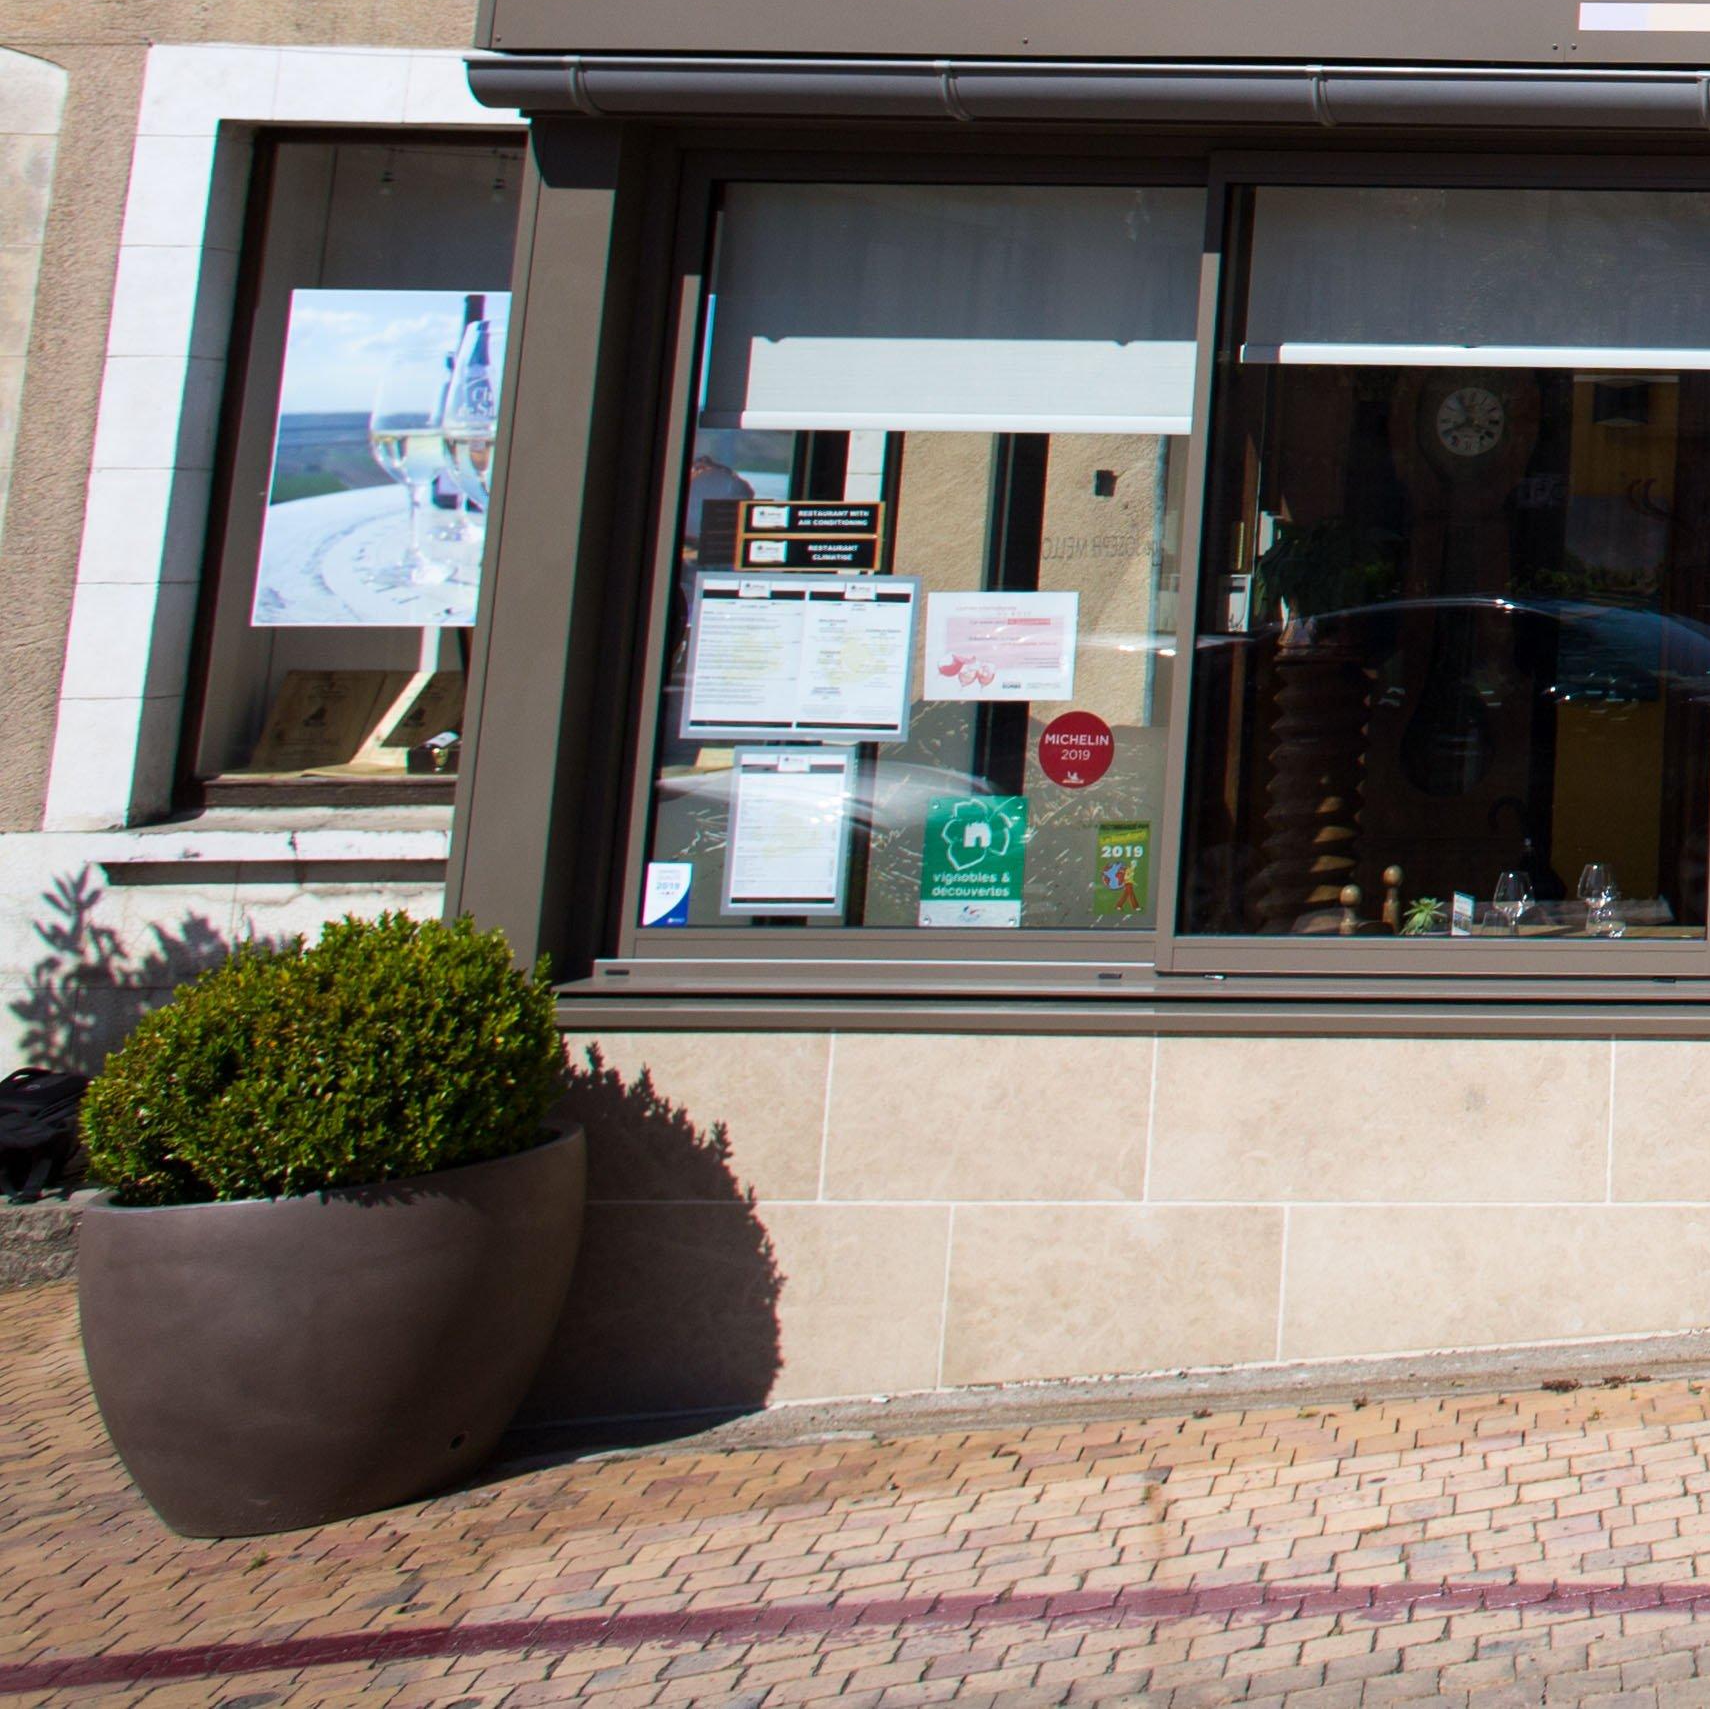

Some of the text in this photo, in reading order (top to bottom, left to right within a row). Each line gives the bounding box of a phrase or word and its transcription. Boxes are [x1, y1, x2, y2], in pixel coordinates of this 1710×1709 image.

[1044, 733, 1110, 746] MICHELIN
[1060, 749, 1091, 761] 2019
[1101, 845, 1144, 859] 2019
[932, 871, 1011, 886] vignobles &
